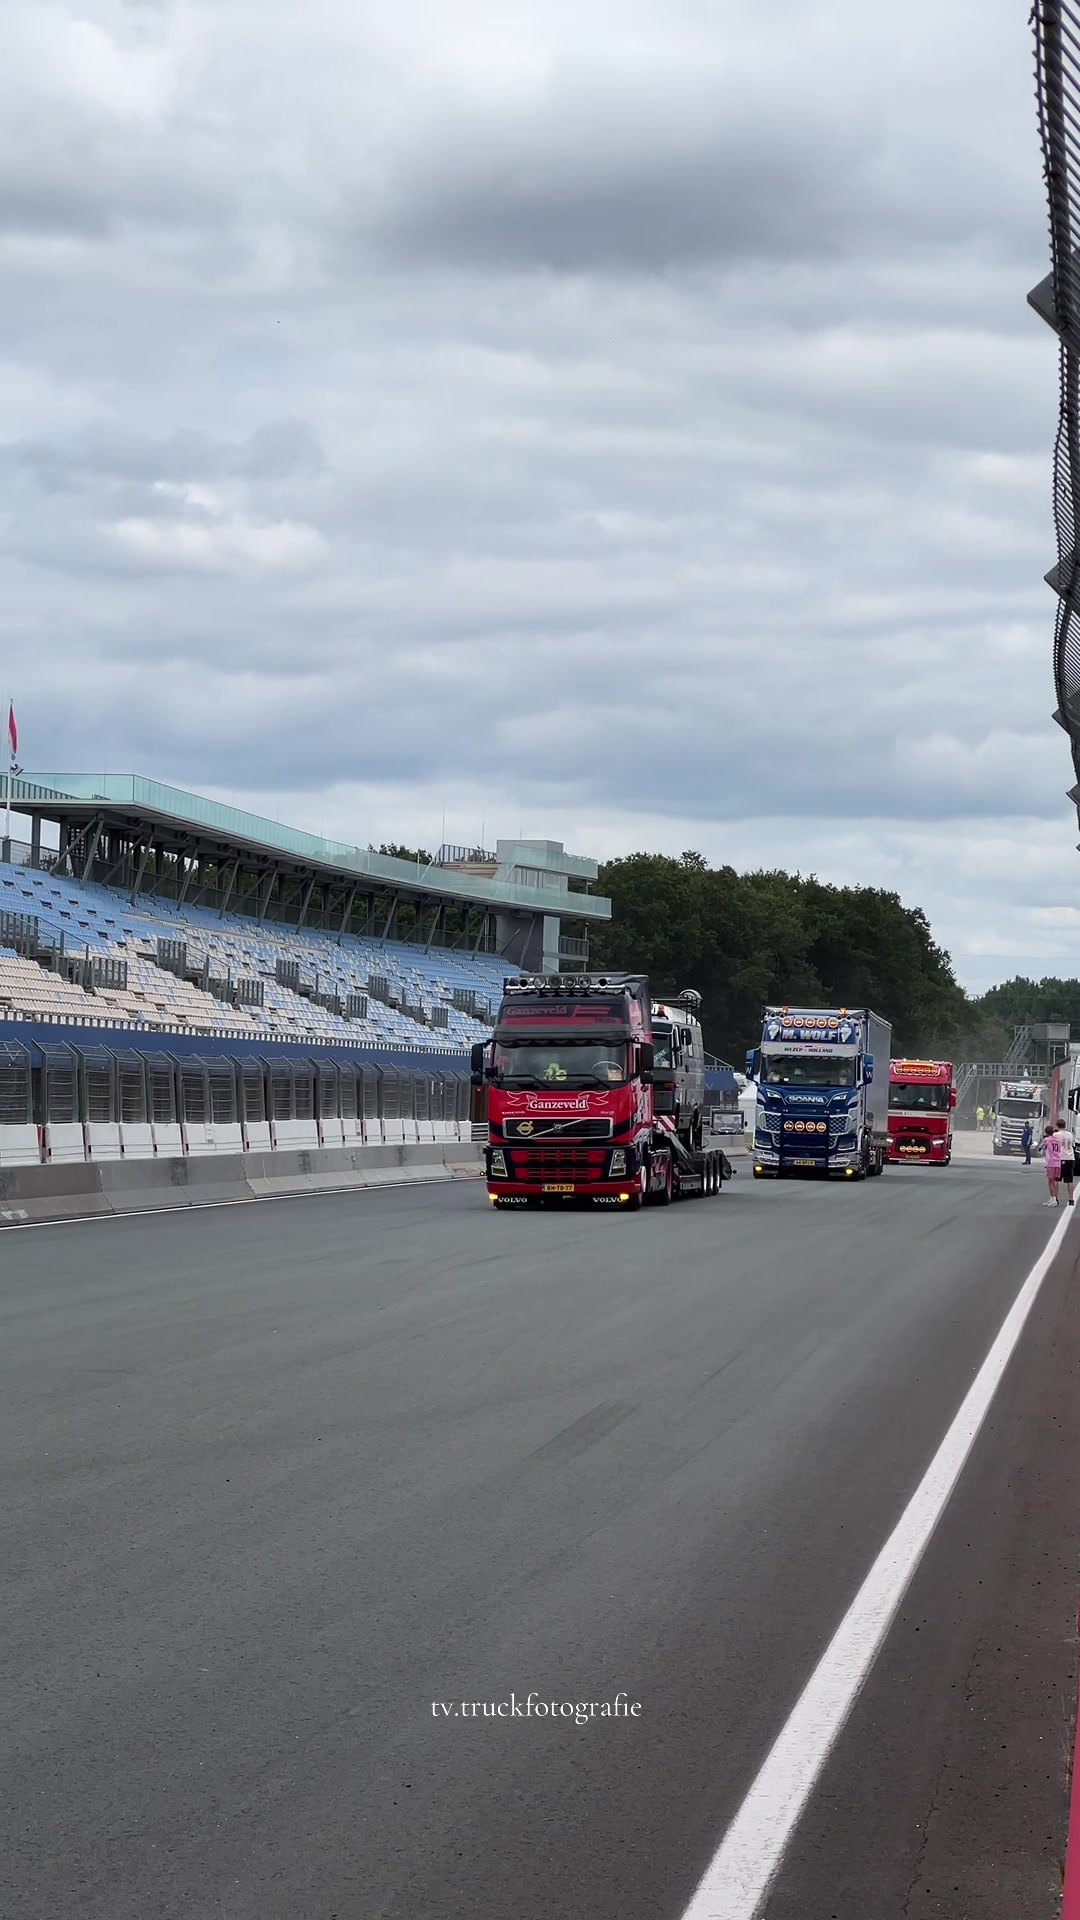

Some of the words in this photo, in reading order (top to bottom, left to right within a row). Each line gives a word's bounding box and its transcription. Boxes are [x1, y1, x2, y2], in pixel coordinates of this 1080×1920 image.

[781, 1029, 797, 1040] M.
[800, 1029, 838, 1041] WOLF
[530, 1099, 587, 1109] Ganzeveld
[788, 1096, 825, 1104] SCANIA
